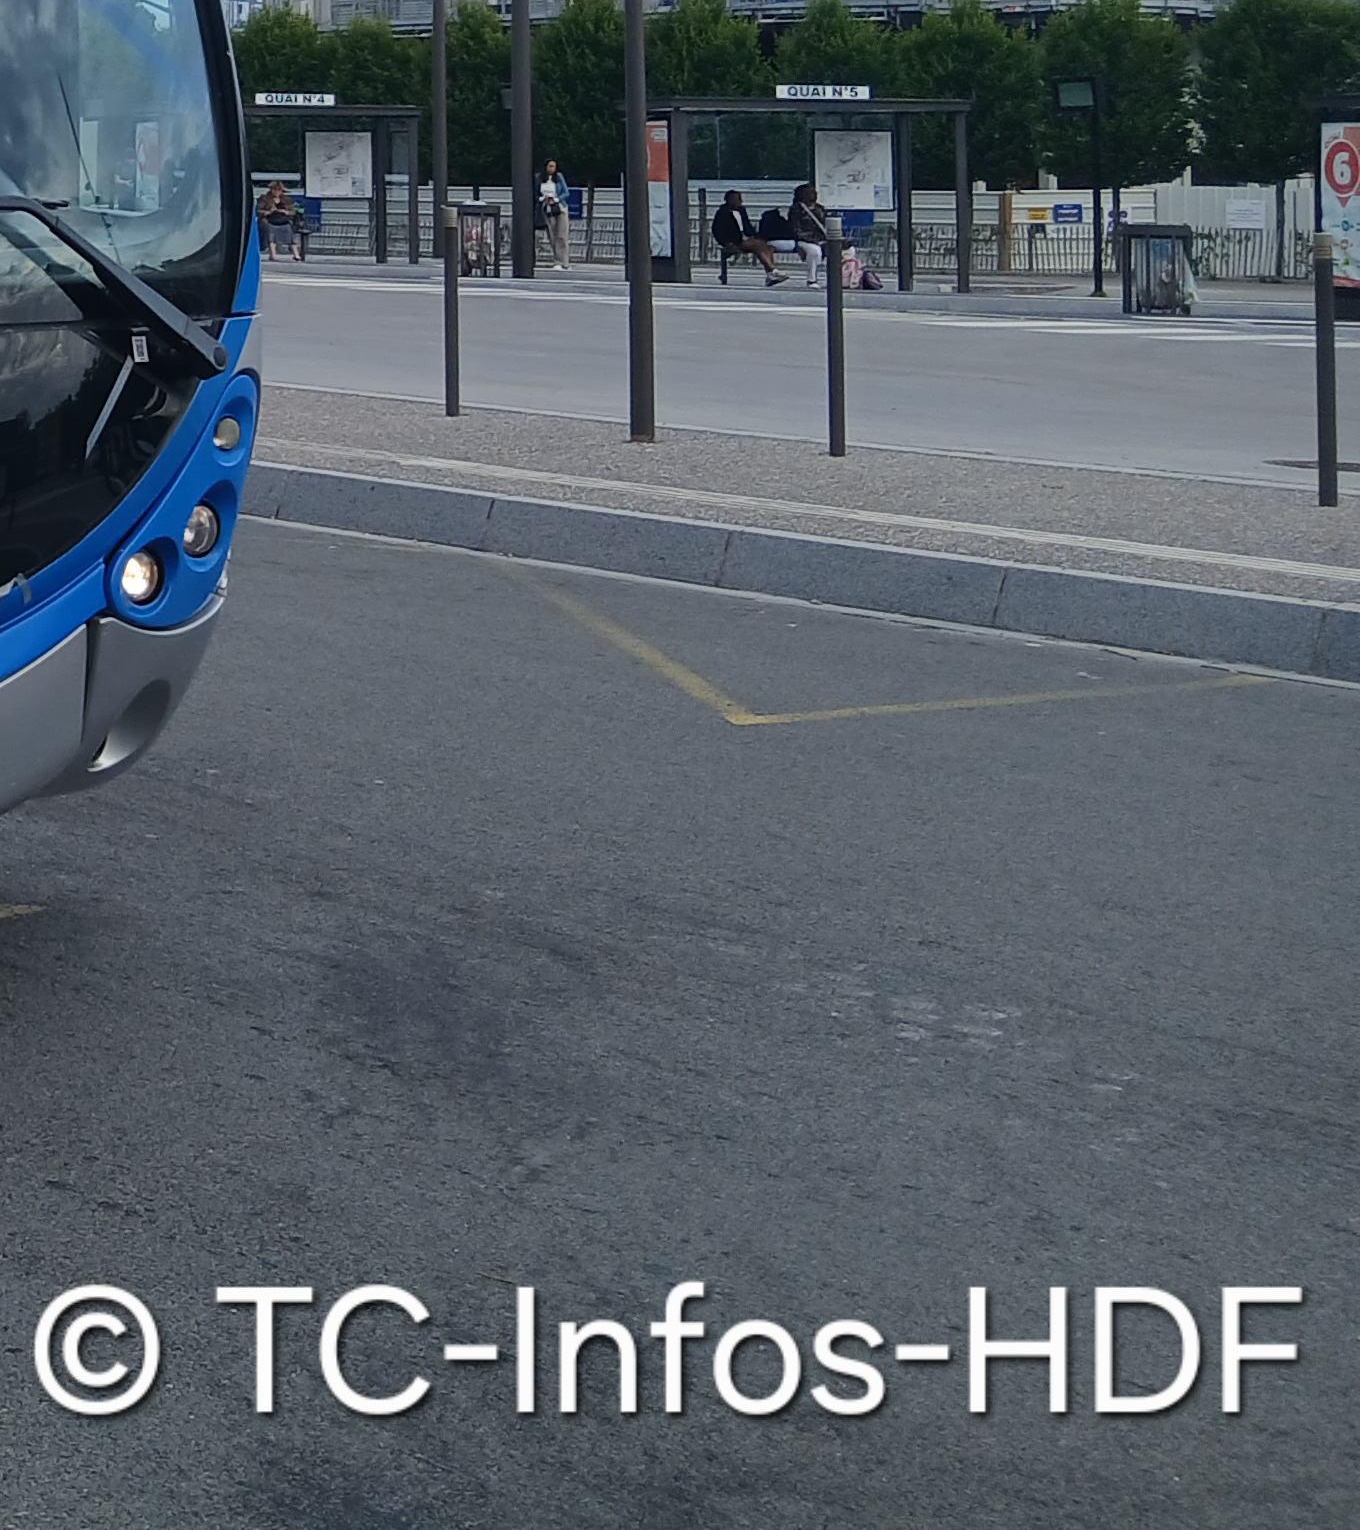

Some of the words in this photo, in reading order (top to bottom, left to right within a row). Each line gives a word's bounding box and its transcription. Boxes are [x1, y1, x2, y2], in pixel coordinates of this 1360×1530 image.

[787, 86, 826, 97] QUAI
[832, 86, 858, 97] N°5
[265, 94, 297, 103] QUAI
[303, 95, 325, 103] N°4
[1333, 151, 1352, 185] 6
